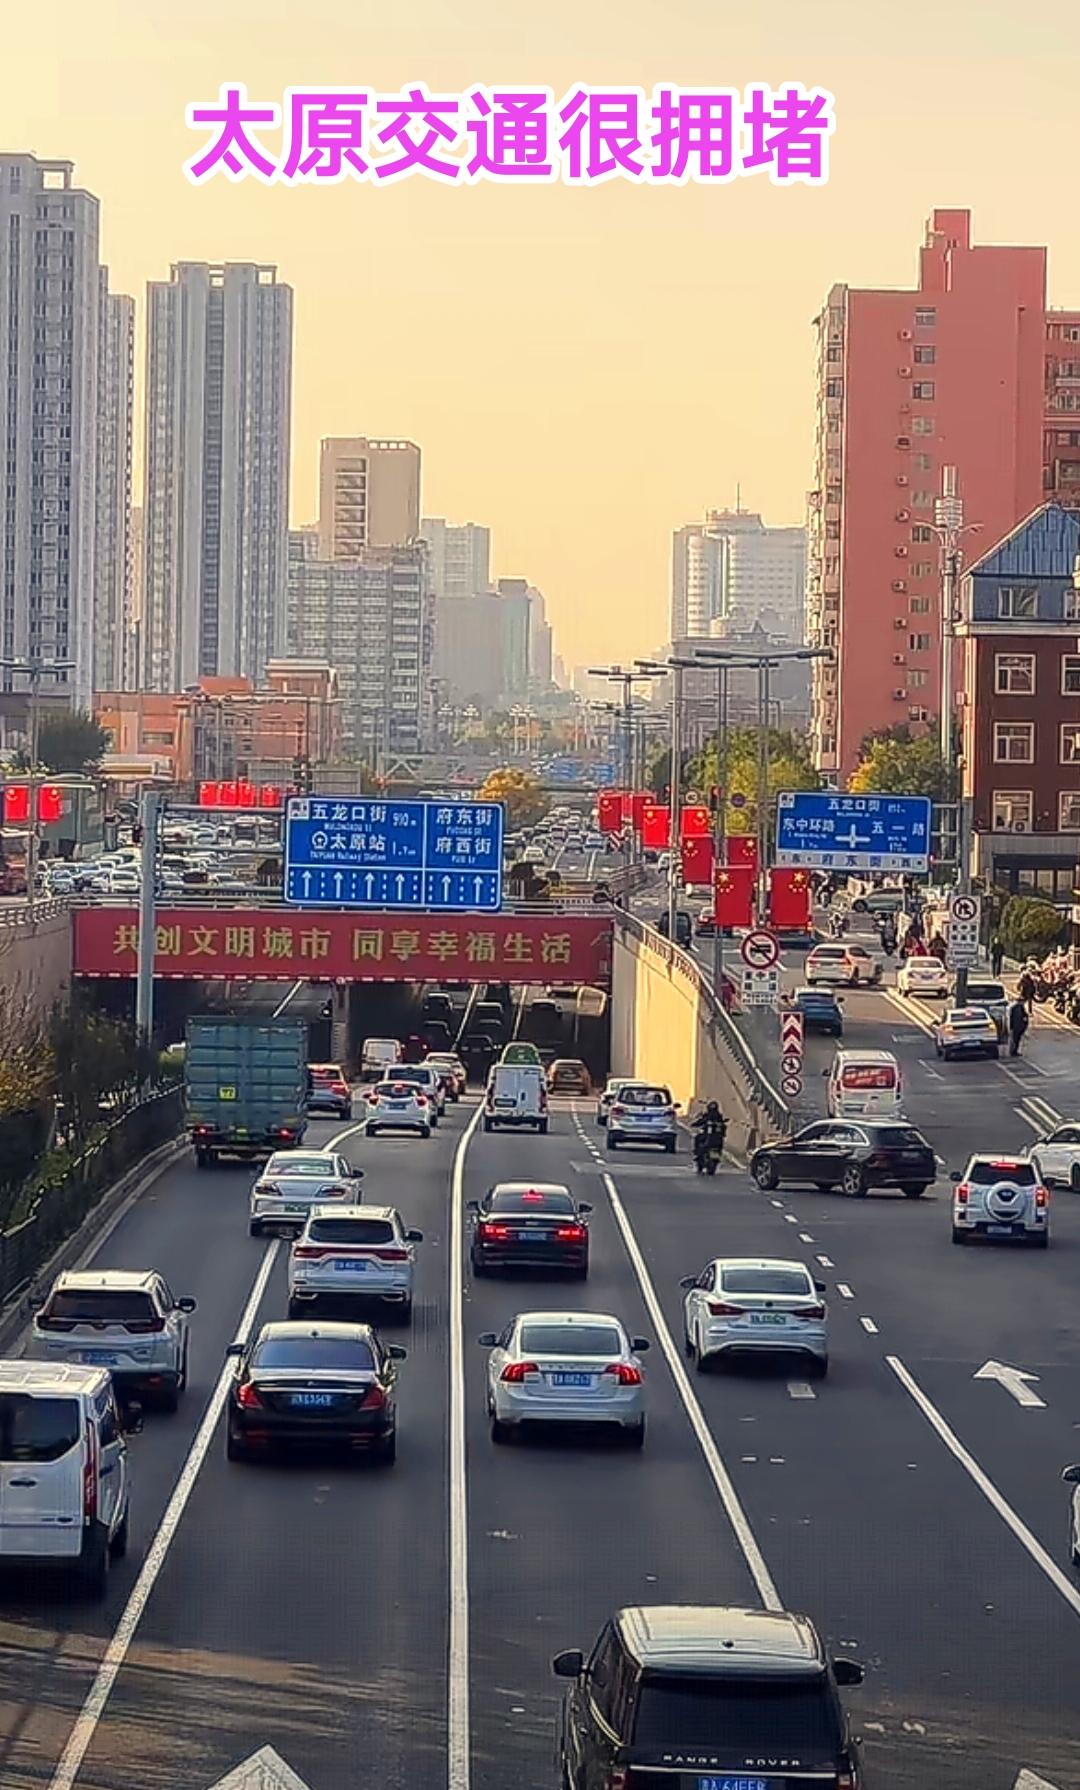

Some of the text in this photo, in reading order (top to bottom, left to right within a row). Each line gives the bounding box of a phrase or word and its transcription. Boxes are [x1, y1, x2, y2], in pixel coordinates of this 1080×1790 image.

[311, 803, 388, 823] 五龙口街
[436, 807, 493, 826] 府东街
[782, 817, 835, 833] 东中环路
[871, 821, 925, 837] 五一路
[329, 833, 387, 851] 太原站
[435, 836, 492, 855] 府西街
[112, 924, 572, 964] 共创文明城市 同享幸福生活
